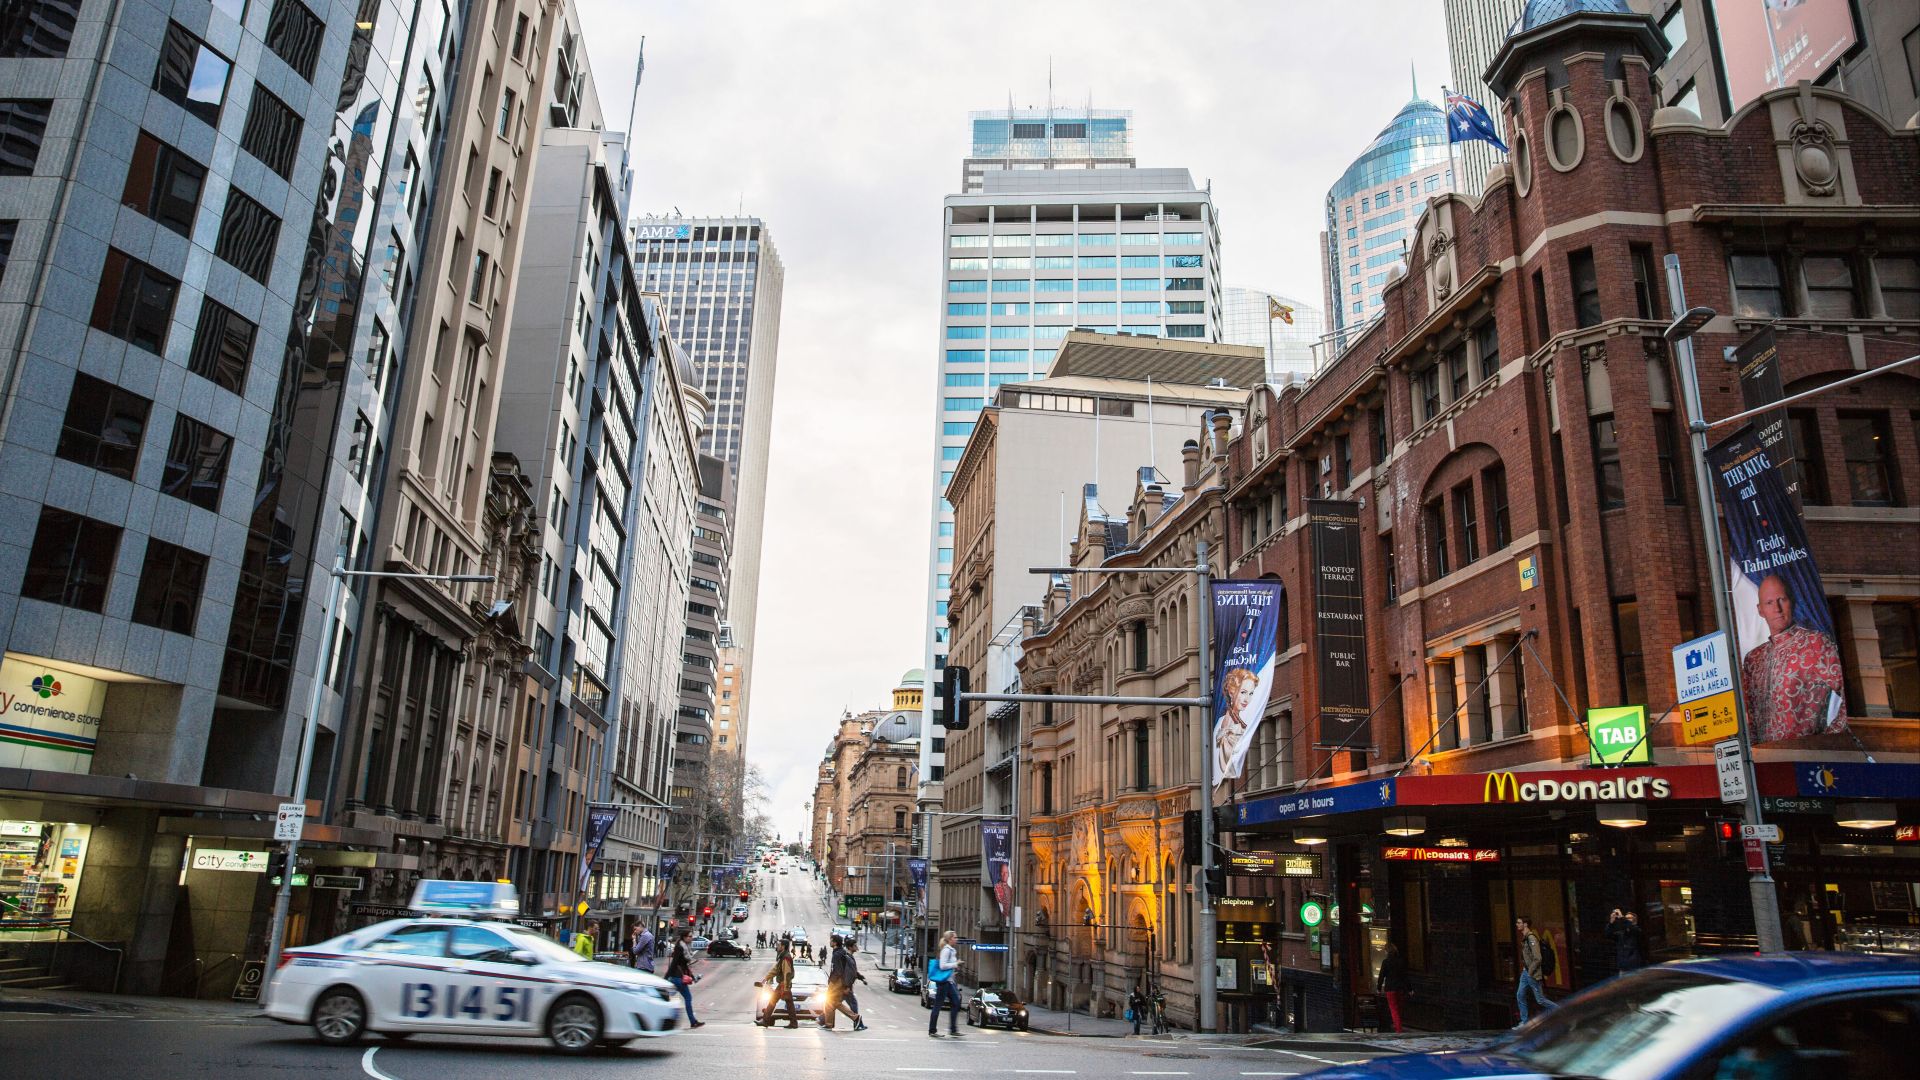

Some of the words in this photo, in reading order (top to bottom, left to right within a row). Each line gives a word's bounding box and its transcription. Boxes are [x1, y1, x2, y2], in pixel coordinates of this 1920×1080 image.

[639, 226, 674, 238] AMP
[1740, 345, 1777, 377] METROPOLITAN
[1758, 420, 1783, 440] OOFTOP
[1763, 431, 1784, 448] RRACE
[1723, 465, 1746, 488] THE
[1743, 453, 1771, 478] KING
[1741, 479, 1757, 500] and
[1752, 500, 1760, 516] I
[1312, 515, 1358, 523] METROPOLITAN
[1757, 534, 1785, 553] Teddy
[1742, 558, 1770, 574] Tahu
[1771, 547, 1807, 567] Rhodes
[1323, 573, 1354, 581] TERRACE
[1524, 568, 1536, 578] TAB
[1318, 612, 1363, 620] RESTAURANT
[1330, 652, 1356, 660] PUBLIC
[1688, 674, 1700, 685] BUS
[1702, 668, 1718, 680] LANE
[1681, 685, 1705, 699] CAMERA
[1708, 678, 1729, 691] AHEAD
[13, 702, 76, 722] convenience
[77, 713, 101, 726] store
[1321, 706, 1369, 714] METROPOLITAN
[1599, 727, 1637, 744] TAB
[1690, 725, 1708, 737] LANE
[1721, 761, 1740, 773] LANE
[1485, 772, 1671, 802] McDonald's
[1279, 803, 1295, 815] open
[1299, 799, 1309, 810] 24
[1312, 797, 1334, 808] hours
[1776, 799, 1810, 810] George
[1812, 800, 1821, 808] St
[1414, 848, 1469, 859] McDonald's
[198, 855, 224, 868] city
[225, 859, 267, 869] convenienc
[1286, 860, 1312, 868] EXCHANGE
[1221, 898, 1254, 906] Telephone
[357, 907, 395, 916] philippe
